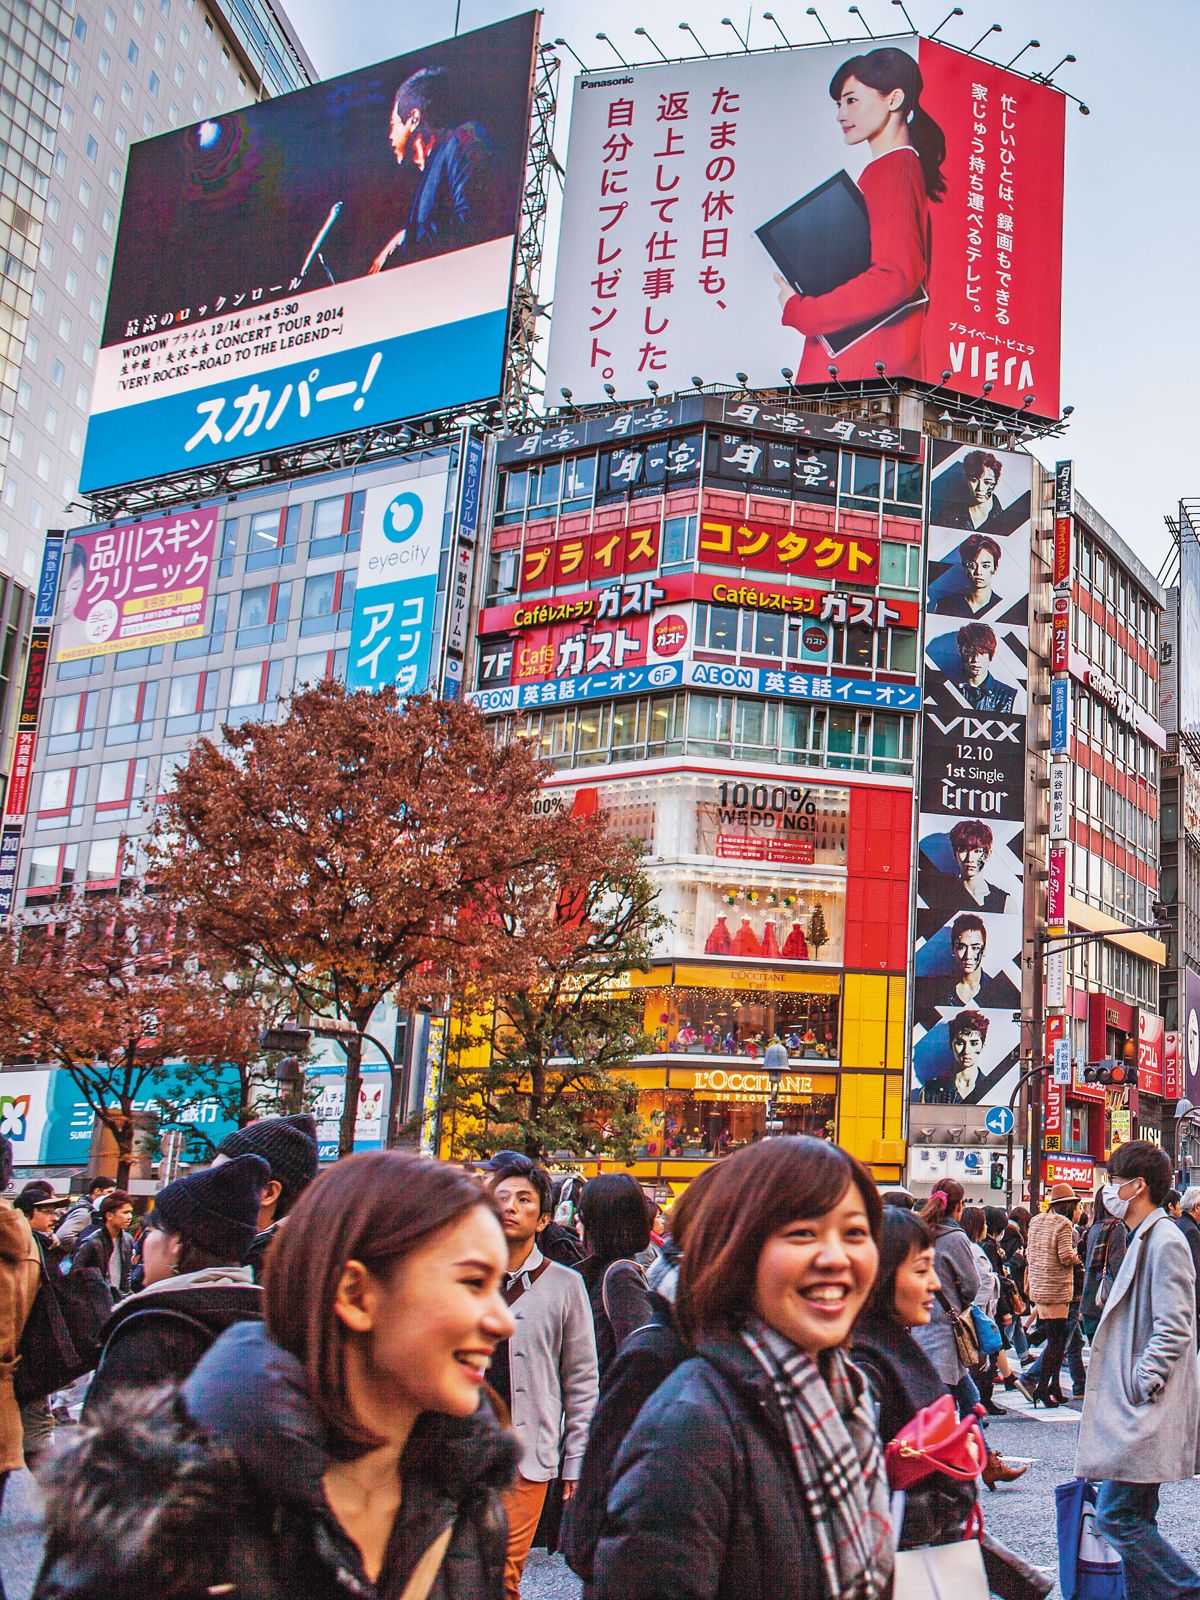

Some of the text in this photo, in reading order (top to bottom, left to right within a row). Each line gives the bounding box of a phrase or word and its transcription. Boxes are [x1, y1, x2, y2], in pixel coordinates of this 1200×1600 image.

[580, 75, 635, 90] Panasonic
[698, 86, 741, 311] たまの休日も、
[965, 82, 989, 314] 家じゅう持ち運べるテレビ。
[994, 93, 1018, 326] 忙しいひとは、録画もできる
[588, 97, 635, 381] 自分にプレゼント。
[637, 90, 690, 373] 返上して仕事した
[125, 276, 301, 337] 最高のロックンロール
[121, 302, 299, 360] WOWOW プライム 12/14 5:30
[214, 325, 272, 351] CONCERT
[277, 316, 312, 335] TOUR
[316, 306, 344, 325] 2014
[948, 321, 1036, 356] プライベート・ビエラ
[234, 345, 252, 361] TO
[254, 338, 277, 358] THE
[949, 340, 1035, 392] VIERA
[183, 351, 383, 452] スカパー！
[725, 403, 806, 433] 月の宴
[605, 407, 669, 436] 月の宴
[723, 434, 741, 446] 9F
[822, 418, 900, 450] 月の宴
[514, 428, 575, 456] 月の宴
[612, 450, 625, 461] 9F
[462, 451, 479, 524] 東急リバブル
[1057, 466, 1071, 503] 月の宴
[88, 518, 214, 572] 品川スキン
[367, 544, 431, 575] eyecity
[523, 525, 658, 582] プライス
[699, 521, 877, 574] コンタクト
[1056, 518, 1067, 579] プライス コンタクト
[39, 550, 59, 613] 東急リバブル
[86, 552, 210, 605] クリニック
[1059, 581, 1070, 590] 8F
[451, 571, 469, 637] 献血ルーム
[596, 581, 667, 620] ガスト
[819, 590, 901, 630] ガスト
[518, 644, 555, 667] Café
[556, 629, 641, 678] ガスト
[655, 631, 686, 647] ガスト
[804, 637, 826, 646] ガスト
[1055, 628, 1067, 665] ガスト
[482, 650, 513, 680] 7F
[522, 671, 644, 705] 英会話イーオン
[653, 667, 673, 683] 6F
[691, 663, 916, 706] AEON 英会話イーオン
[926, 711, 1022, 745] VIXX
[1054, 686, 1066, 748] 英会話イーオン
[15, 733, 33, 779] 外貨両替
[955, 744, 994, 763] 12.10
[945, 762, 1005, 783] 1st Single
[718, 782, 817, 816] 1000%
[940, 777, 1010, 814] Error
[1053, 769, 1063, 834] 渋谷駅前ビル
[717, 808, 816, 832] WEDDING!
[1050, 848, 1065, 858] 5F
[730, 970, 787, 983] L'OCCITANE
[1060, 1042, 1069, 1081] 渋谷駅前
[1139, 1043, 1158, 1069] アコム
[1166, 1058, 1176, 1086] アコム
[715, 1093, 793, 1104] EN PROVECE
[1144, 1074, 1153, 1089] 3F
[1046, 1135, 1060, 1150] 薬
